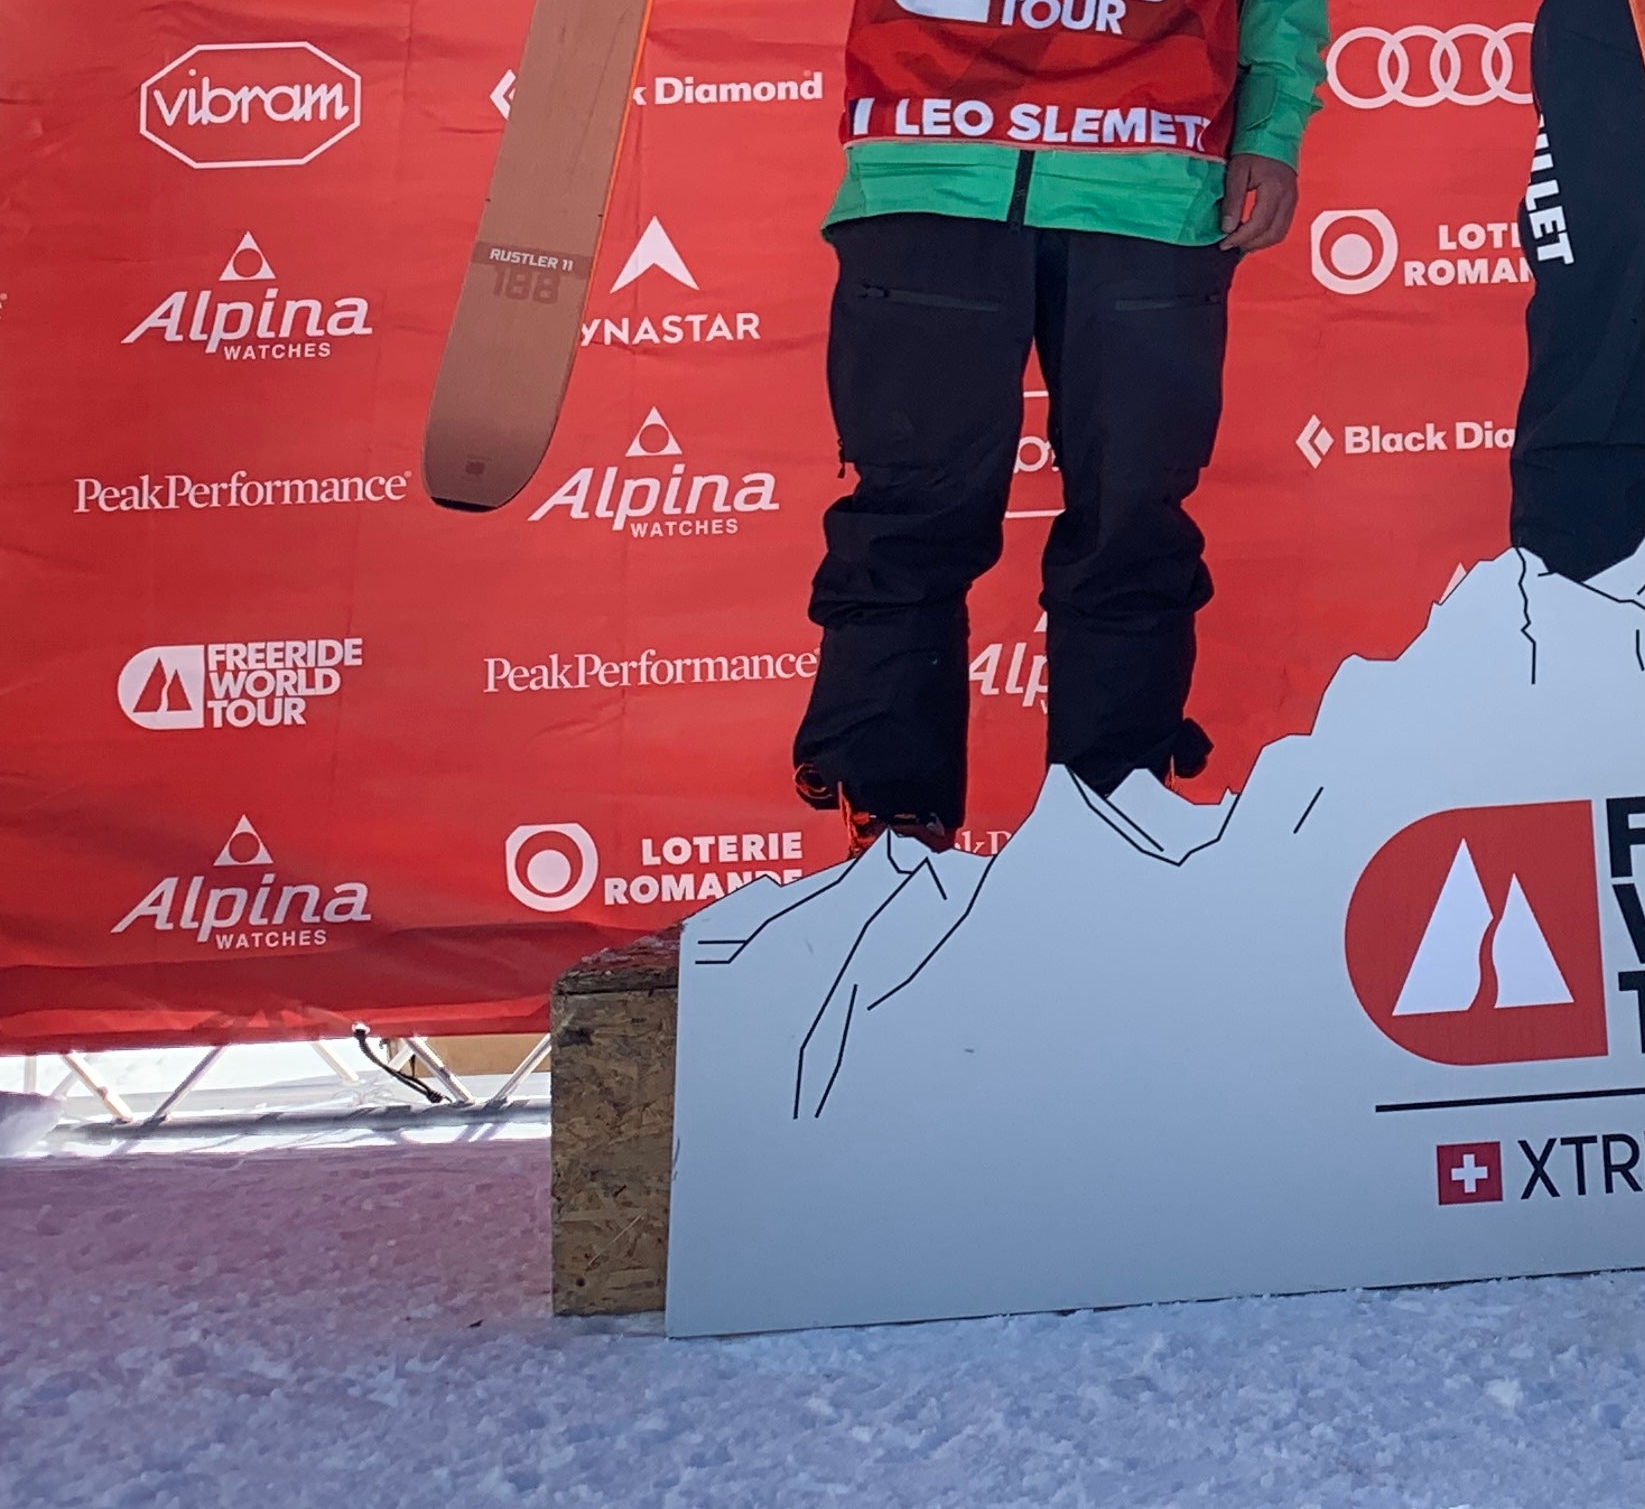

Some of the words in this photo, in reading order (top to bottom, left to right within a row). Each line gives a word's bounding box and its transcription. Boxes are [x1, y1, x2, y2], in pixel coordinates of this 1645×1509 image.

[153, 68, 350, 127] vibram
[654, 70, 824, 107] Diamond
[893, 98, 993, 138] LEO
[488, 246, 557, 270] RUSTLER
[560, 258, 574, 272] 11
[1403, 256, 1534, 288] ROMAN
[493, 268, 561, 305] 188
[121, 287, 373, 359] Alpina
[580, 312, 761, 347] YNASTAR
[223, 342, 331, 361] WATCHES
[1344, 423, 1448, 454] Black
[527, 463, 780, 538] Alpina
[630, 518, 738, 538] WATCHES
[207, 637, 363, 671] FREERIDE
[209, 667, 341, 700] WORLD
[206, 697, 307, 728] TOUR
[641, 831, 803, 866] LOTERIE
[110, 873, 372, 947] Alpina
[215, 929, 327, 950] WATCHES
